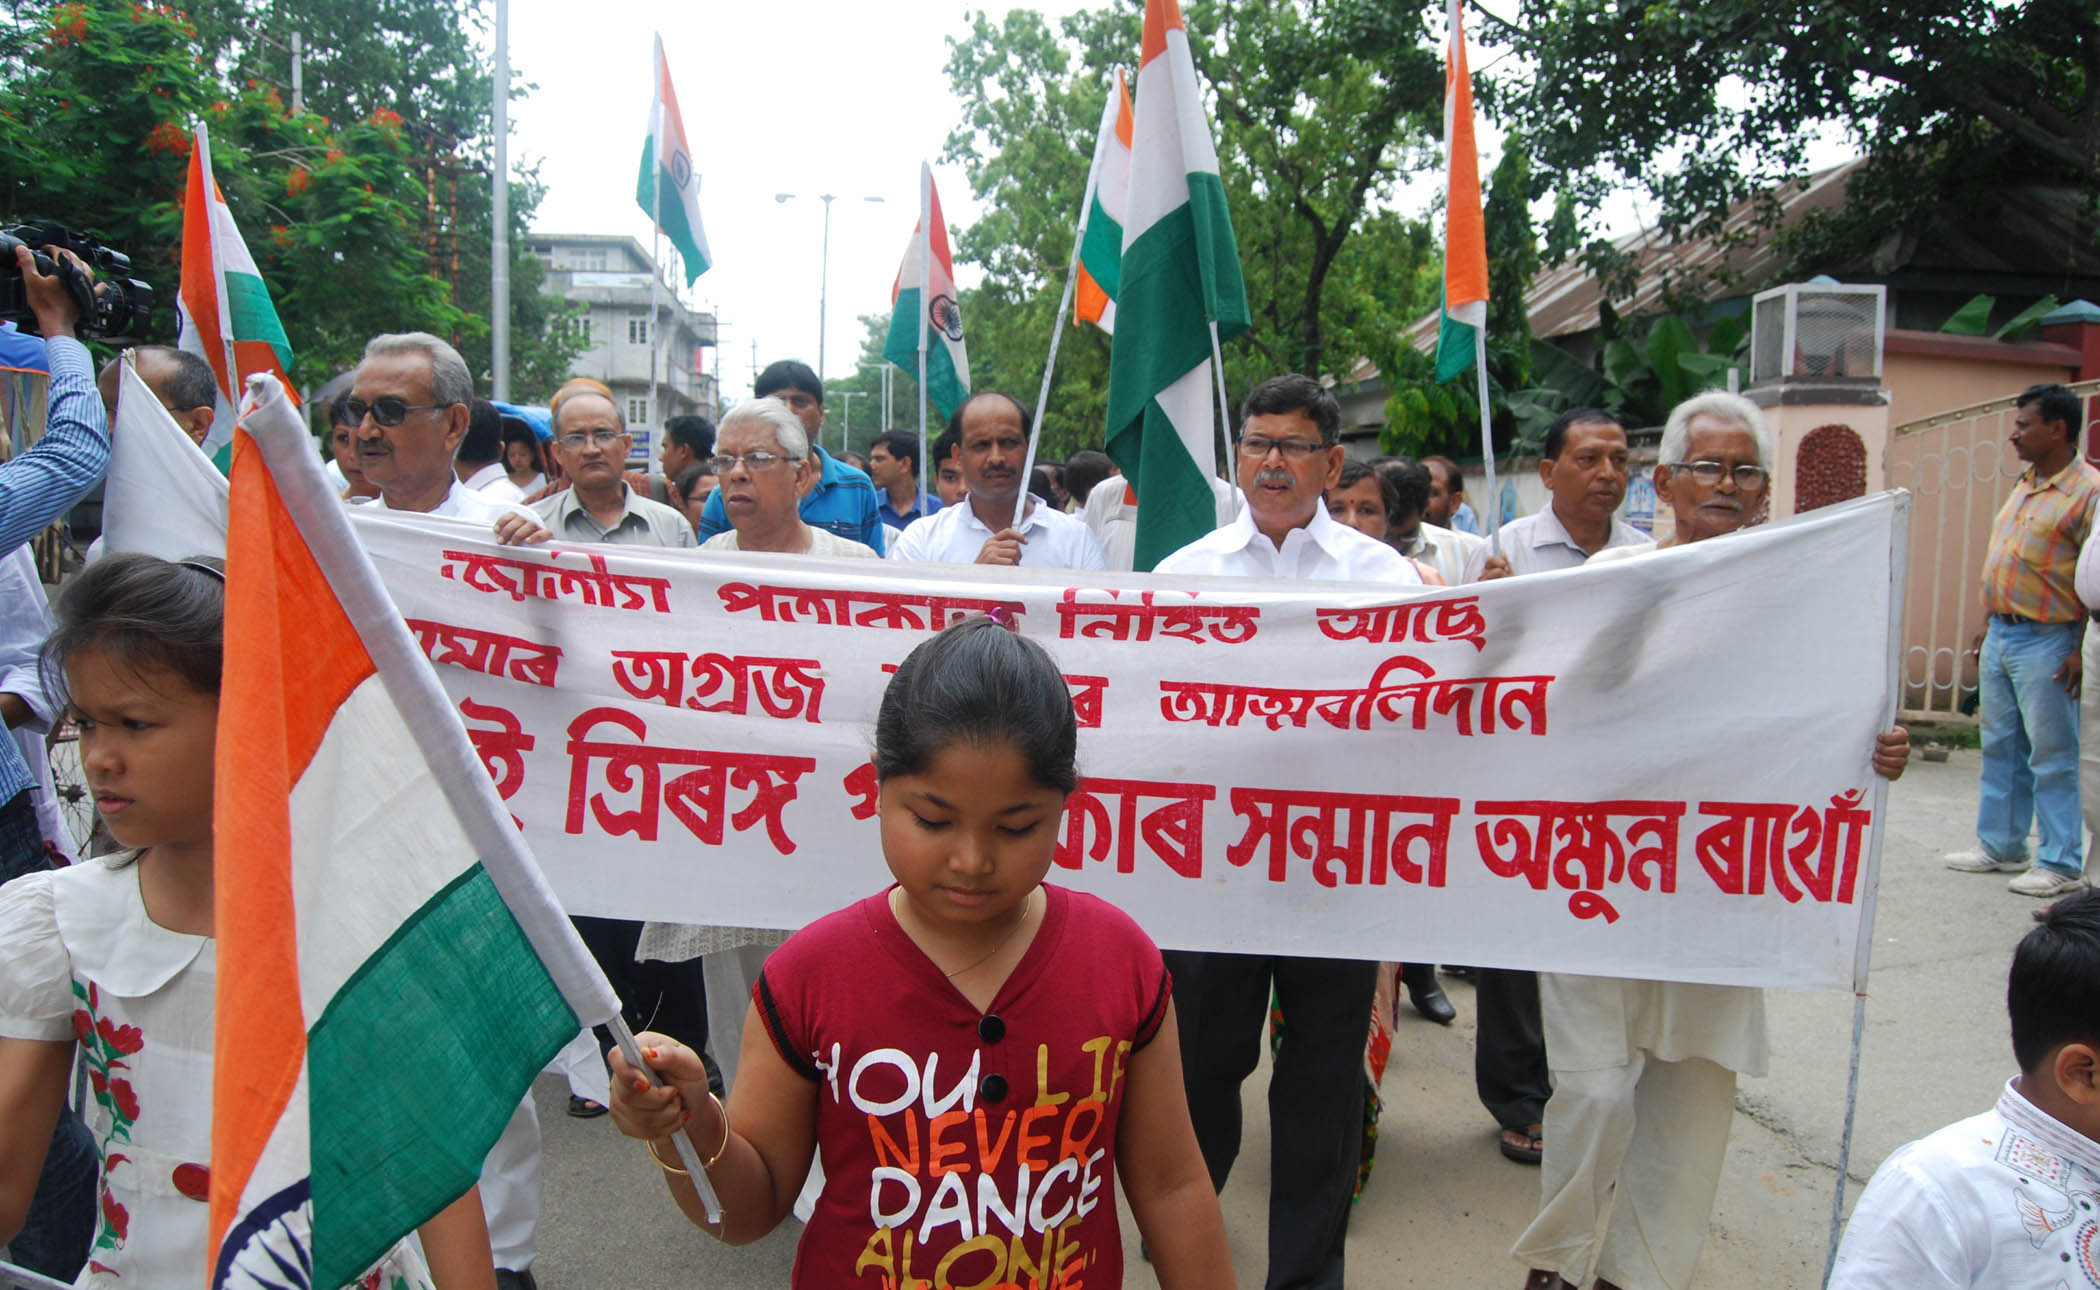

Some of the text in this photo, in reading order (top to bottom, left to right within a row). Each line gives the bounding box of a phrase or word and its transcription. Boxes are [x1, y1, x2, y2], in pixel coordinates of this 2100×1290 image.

[1316, 596, 1487, 652] আছে
[812, 1036, 1133, 1120] YOU LIF
[868, 1100, 1104, 1178] NEVER
[870, 1147, 1105, 1245] DANCE
